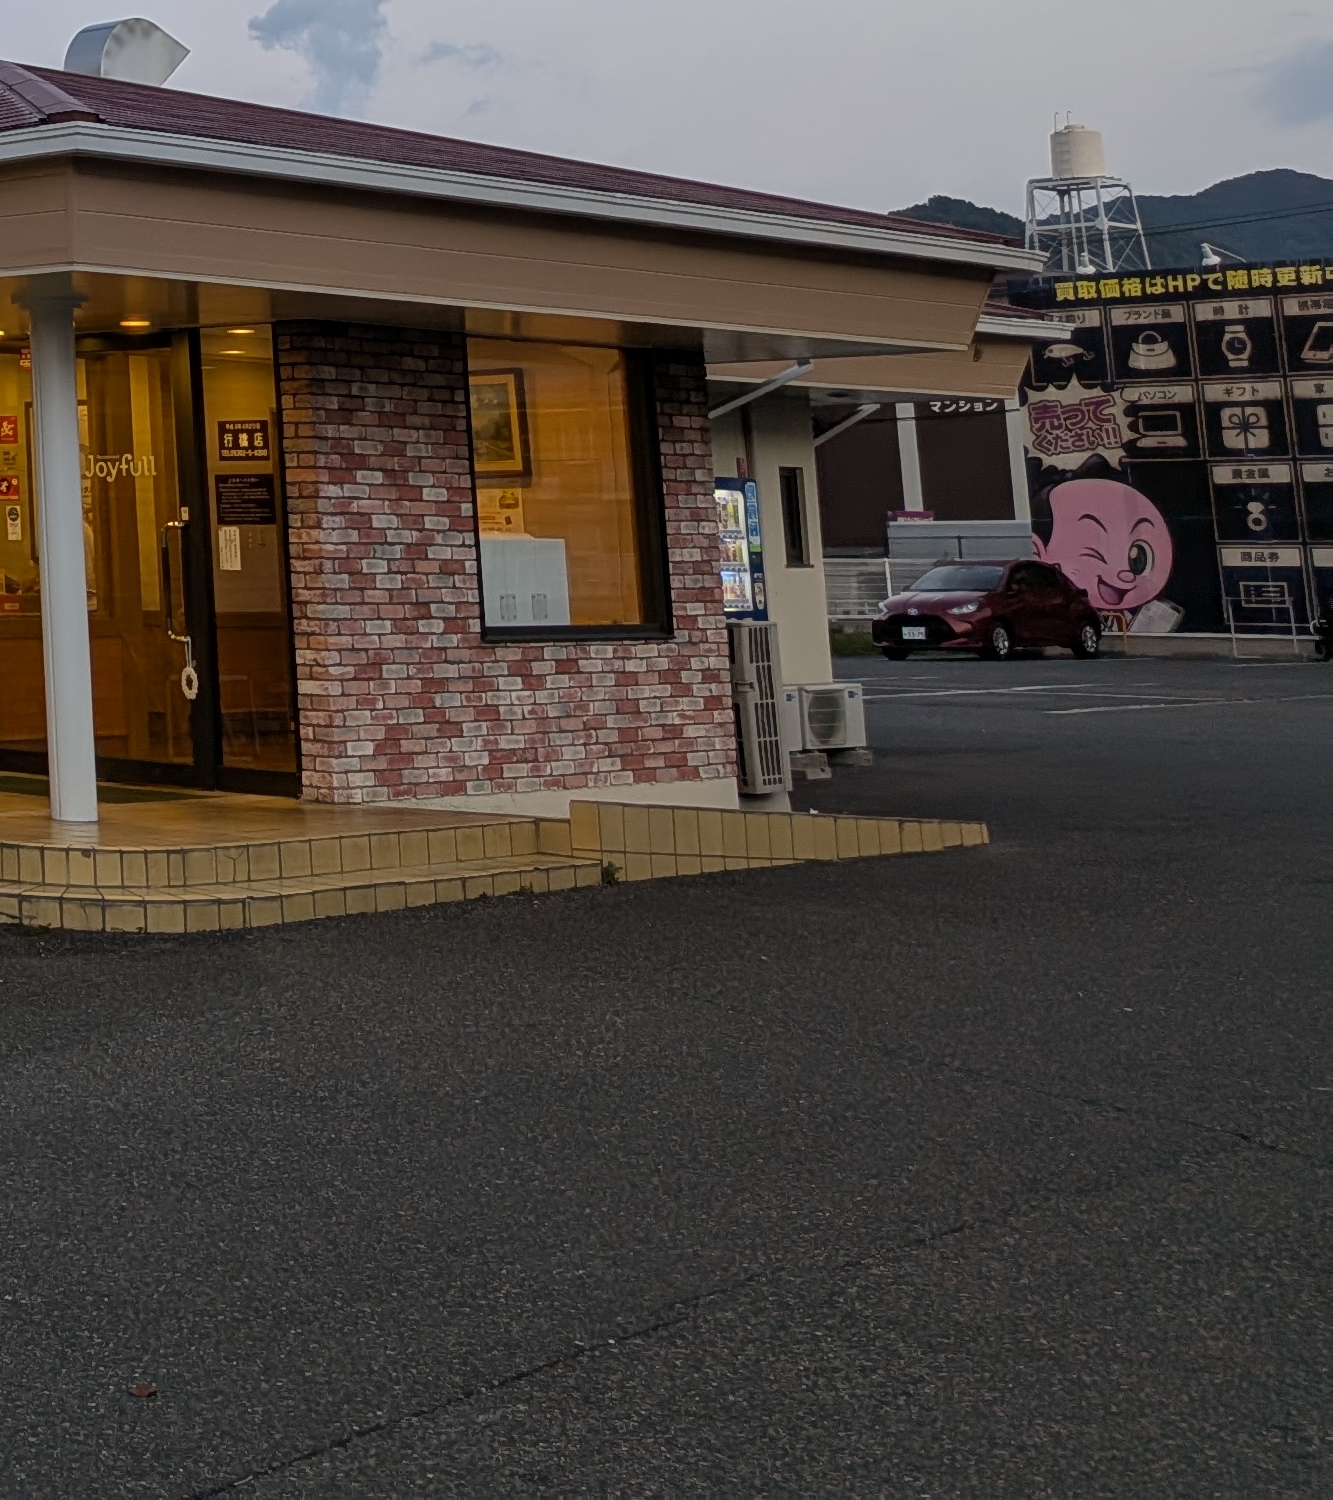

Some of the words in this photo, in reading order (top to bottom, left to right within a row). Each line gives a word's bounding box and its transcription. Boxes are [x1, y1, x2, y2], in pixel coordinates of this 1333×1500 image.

[1222, 386, 1260, 398] ギフト
[930, 400, 998, 412] マンション
[1029, 396, 1116, 432] 売って
[84, 453, 158, 483] Joyfull
